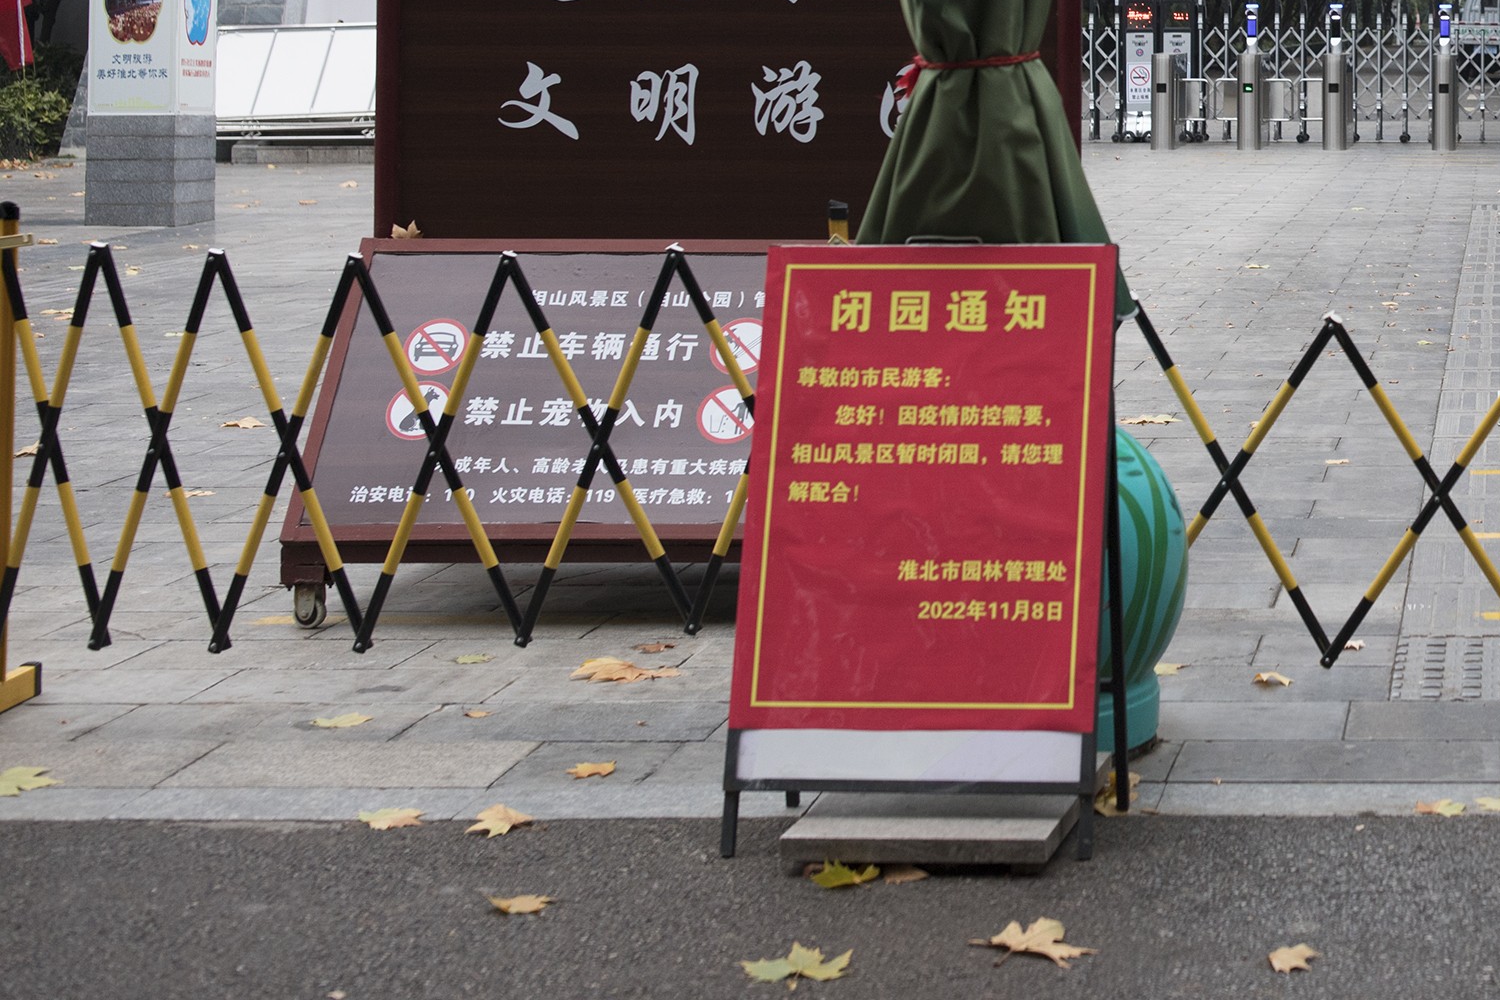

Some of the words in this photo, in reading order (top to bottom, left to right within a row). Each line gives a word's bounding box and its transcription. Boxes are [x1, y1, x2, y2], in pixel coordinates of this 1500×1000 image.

[830, 289, 1047, 333] 闭园通知
[480, 331, 699, 362] 禁止车辆通行
[897, 559, 1068, 582] 淮北市园林管理处
[917, 599, 1064, 623] 2022年11月8日
